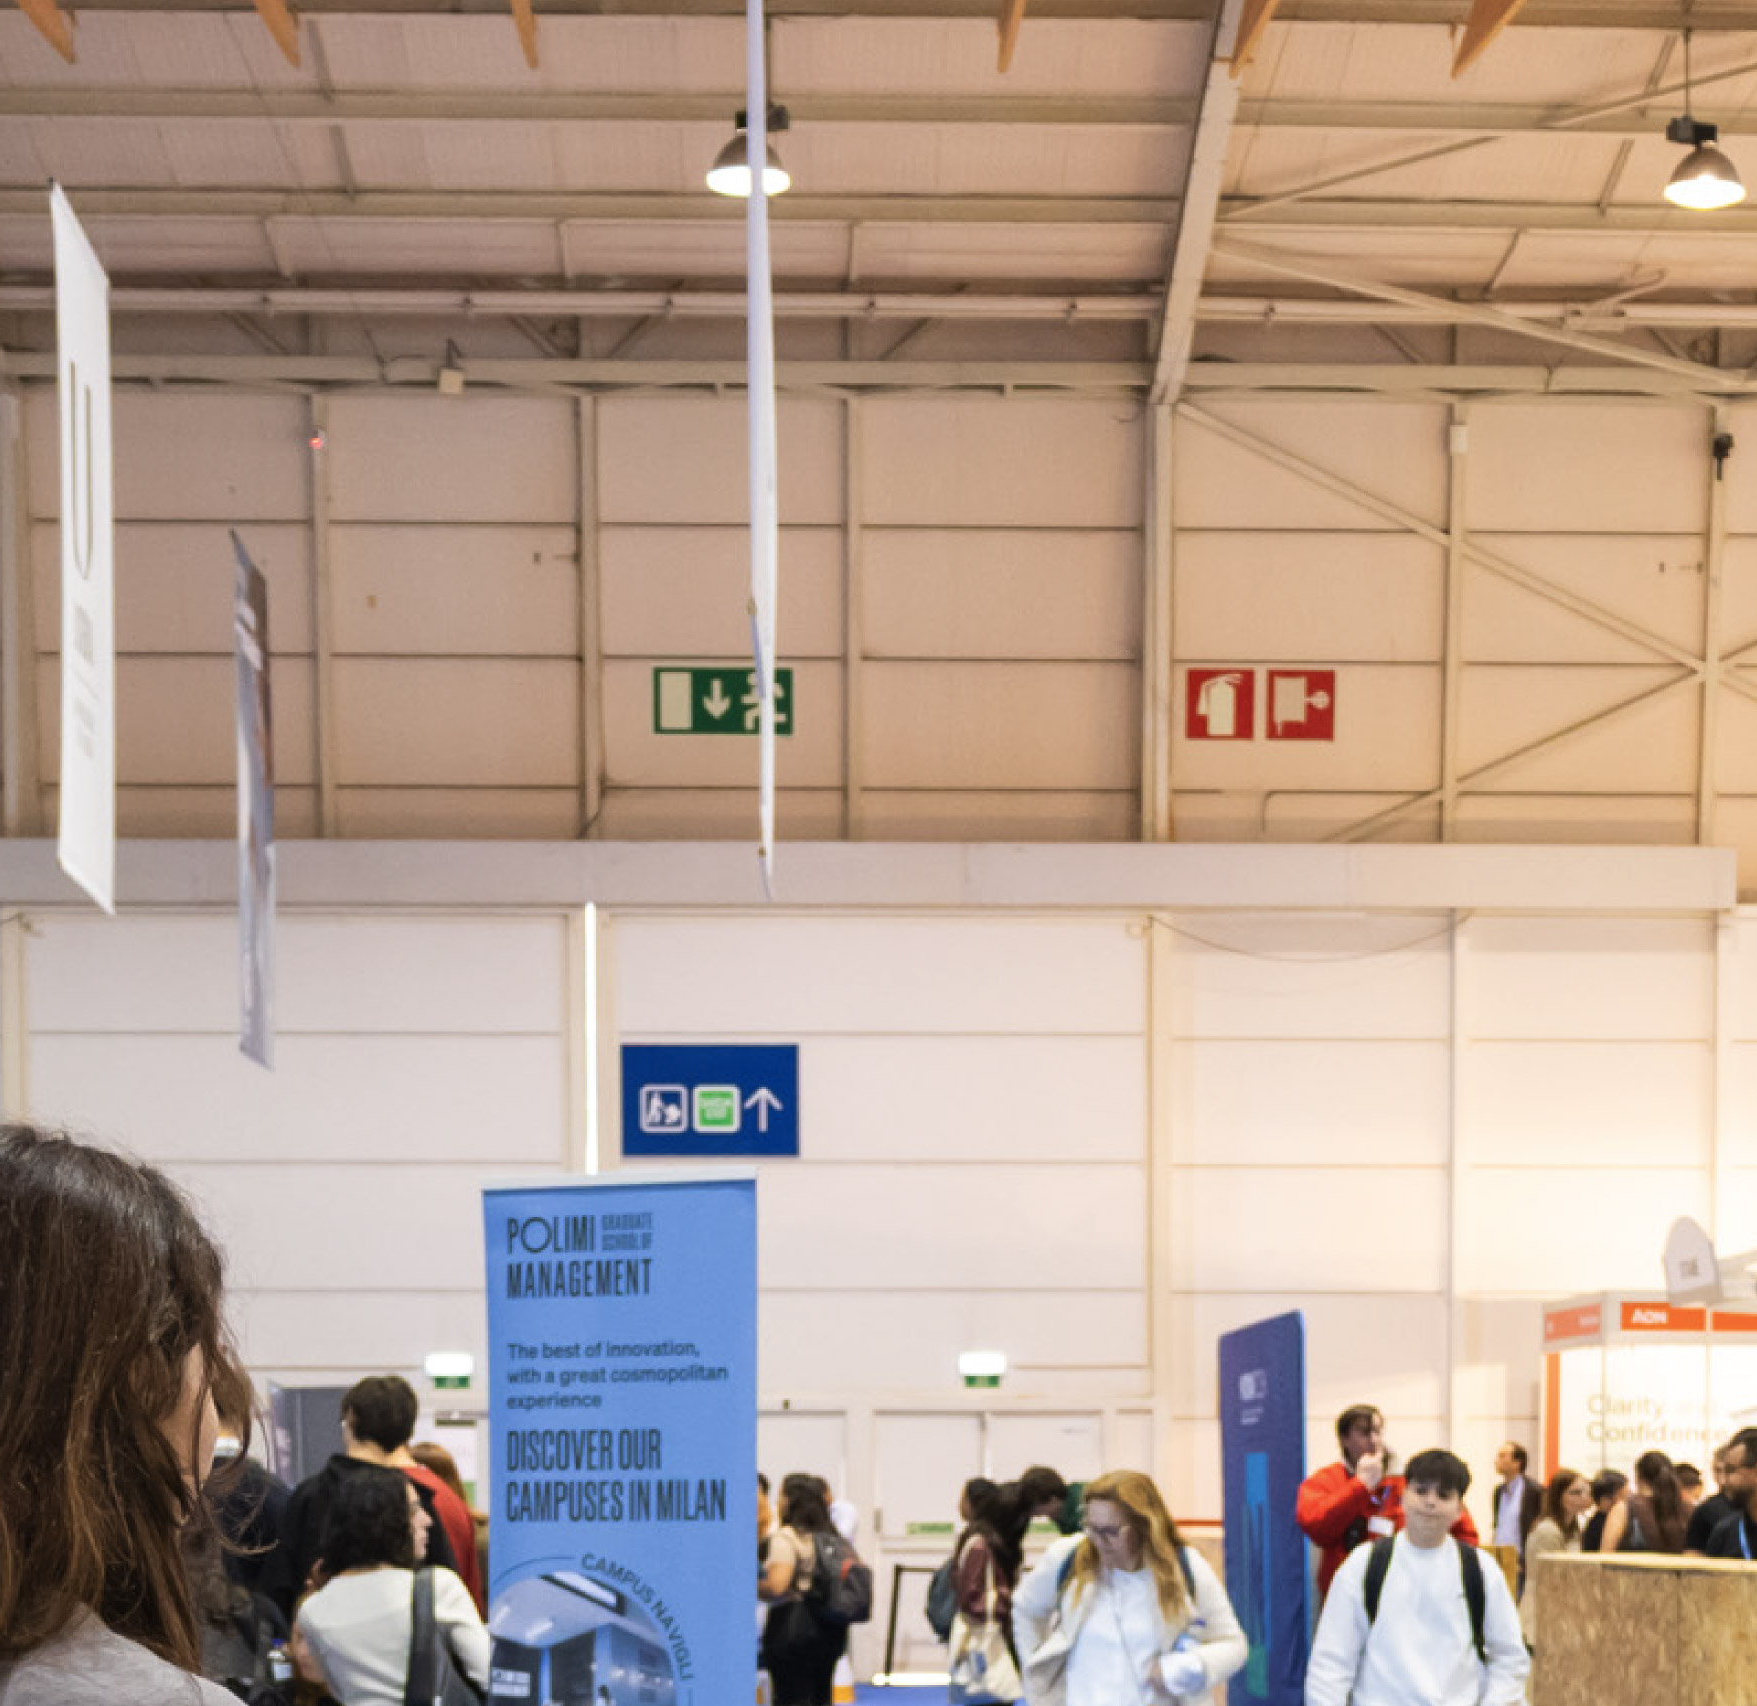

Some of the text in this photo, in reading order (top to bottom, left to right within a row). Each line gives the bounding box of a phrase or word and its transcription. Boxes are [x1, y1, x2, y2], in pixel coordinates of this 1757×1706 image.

[507, 1216, 595, 1254] POLIMI
[507, 1258, 652, 1299] MANAGEMENT
[508, 1340, 700, 1359] The best of innovation,
[507, 1365, 729, 1387] with a great cosmopolitan
[507, 1394, 603, 1412] experience
[507, 1428, 662, 1471] DISCOVER OUR
[1586, 1421, 1729, 1442] Confidence
[507, 1479, 726, 1522] CAMPUSES IN MILAN
[581, 1552, 656, 1603] CAMPUS
